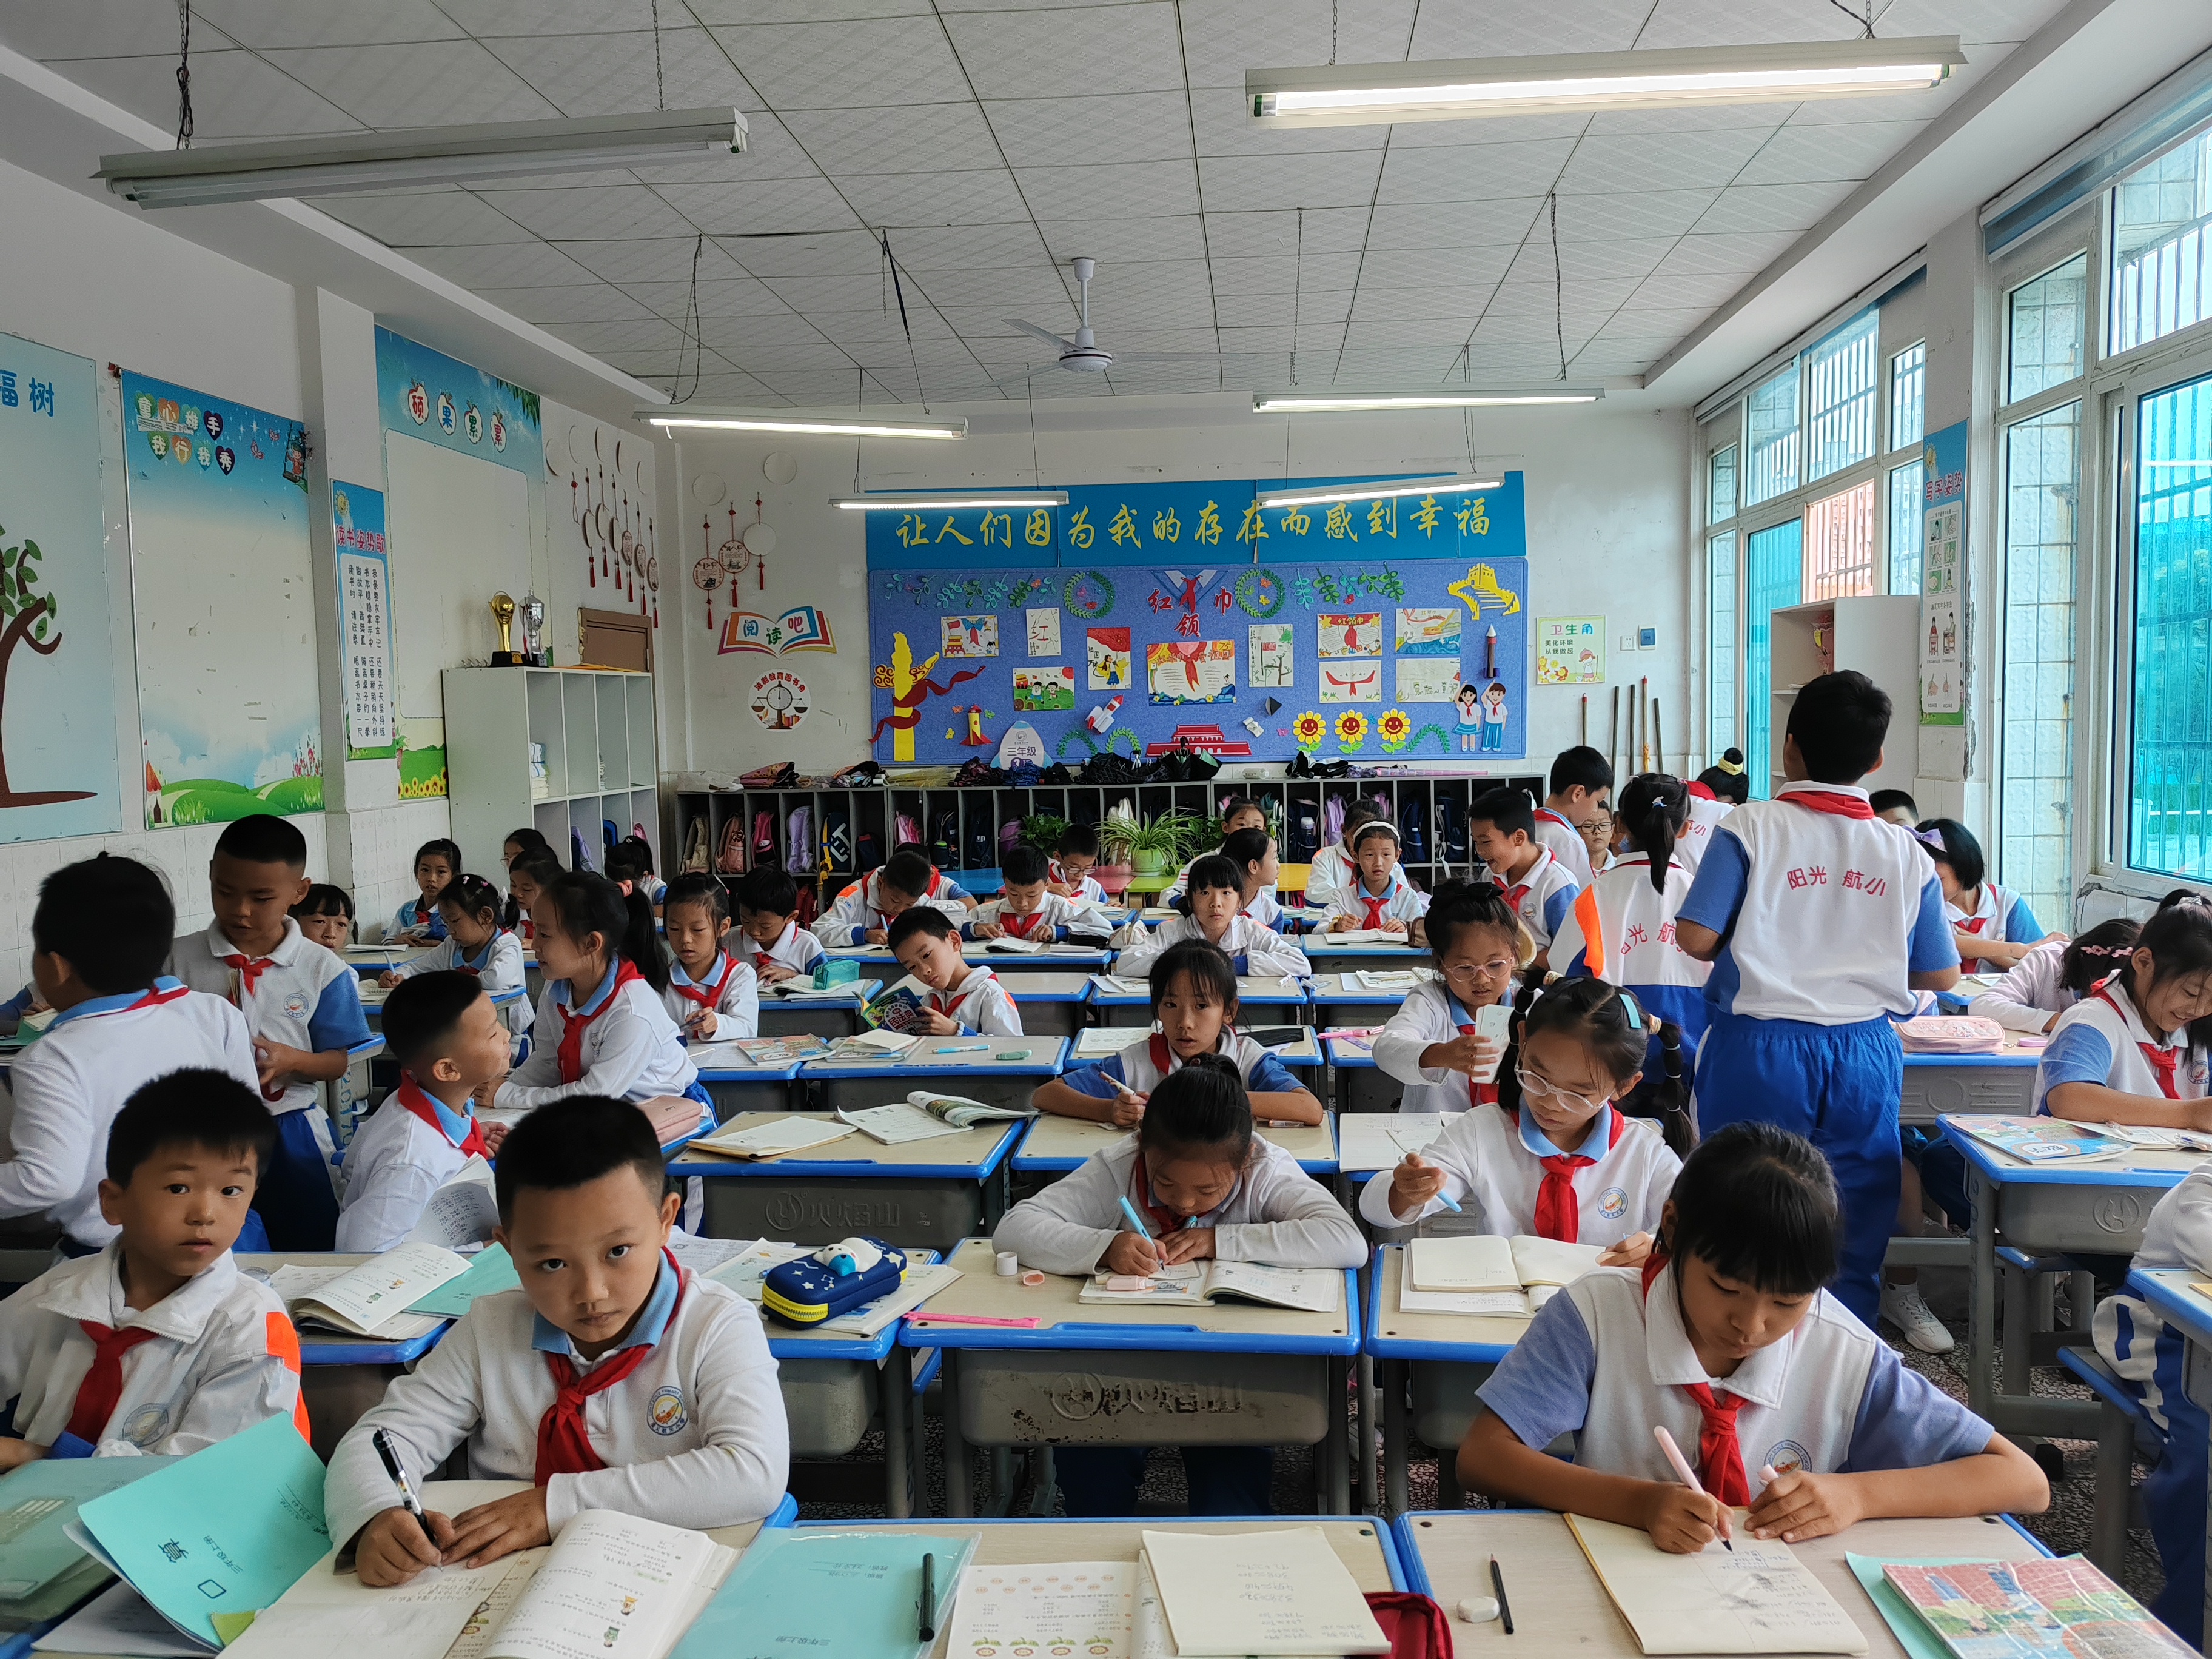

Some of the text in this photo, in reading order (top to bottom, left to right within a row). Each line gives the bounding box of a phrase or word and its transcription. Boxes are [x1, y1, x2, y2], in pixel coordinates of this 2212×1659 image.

[412, 395, 503, 447] 硕果累累
[152, 435, 233, 472] 我行我秀
[1925, 471, 1963, 501] 写字姿势
[896, 494, 1490, 549] 让人们因为我的存在而感到幸福
[337, 525, 386, 554] 读书姿势歌
[743, 616, 805, 645] 阅读吧
[1545, 638, 1574, 647] 美化环境
[1550, 623, 1594, 635] 卫生角
[1007, 746, 1037, 757] 三年级
[1786, 865, 1886, 897] 阳光 航小
[203, 1534, 244, 1575] 三年级上册
